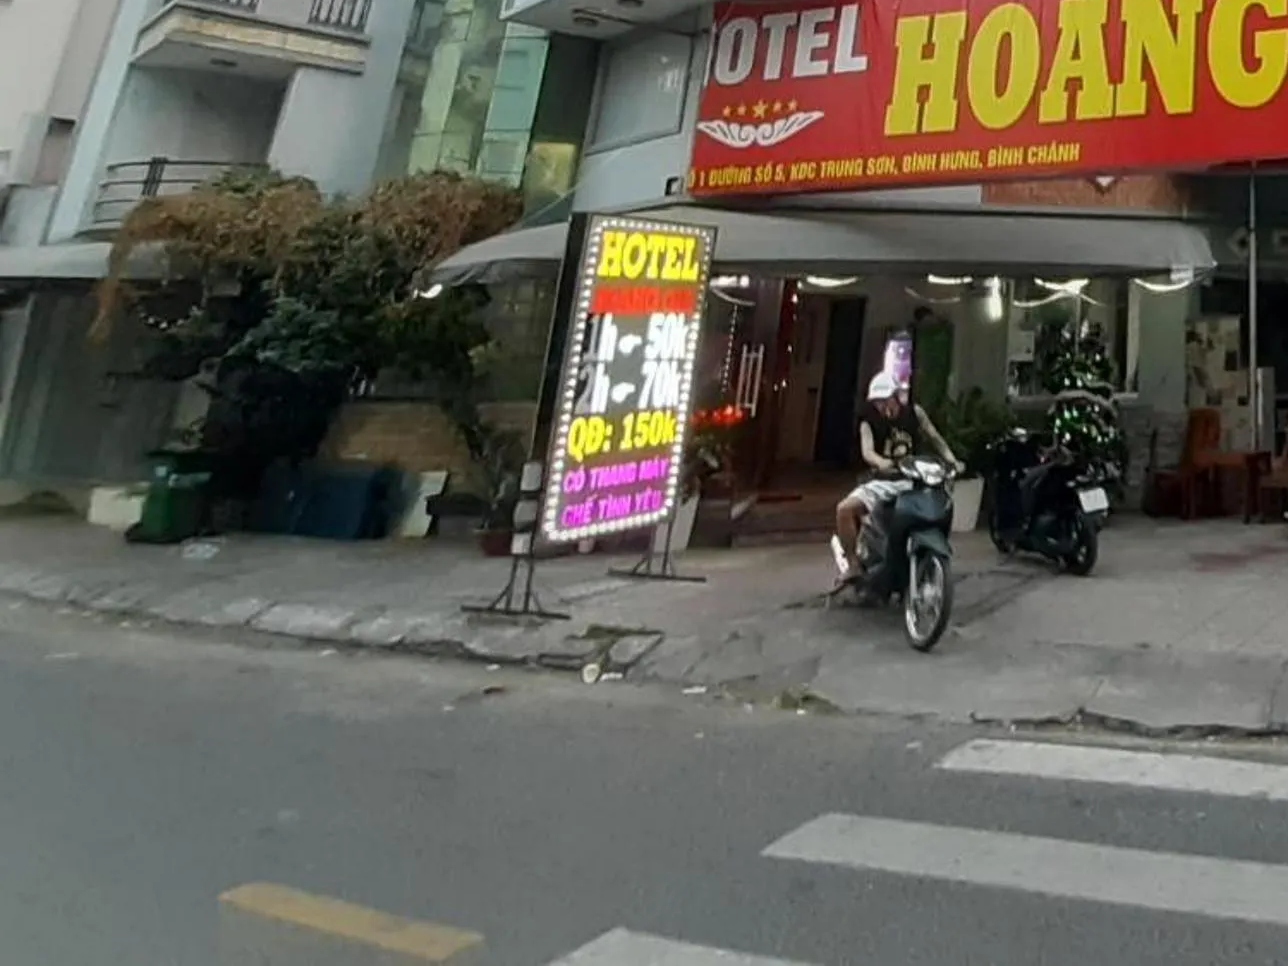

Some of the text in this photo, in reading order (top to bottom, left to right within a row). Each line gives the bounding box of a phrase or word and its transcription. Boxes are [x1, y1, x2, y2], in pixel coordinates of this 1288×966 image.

[703, 3, 868, 87] OTEL
[819, 157, 863, 180] TRUNG
[987, 144, 1024, 168] BÌNH
[1027, 139, 1081, 165] CHÁNH
[597, 229, 699, 281] HOTEL
[620, 409, 677, 450] 150k
